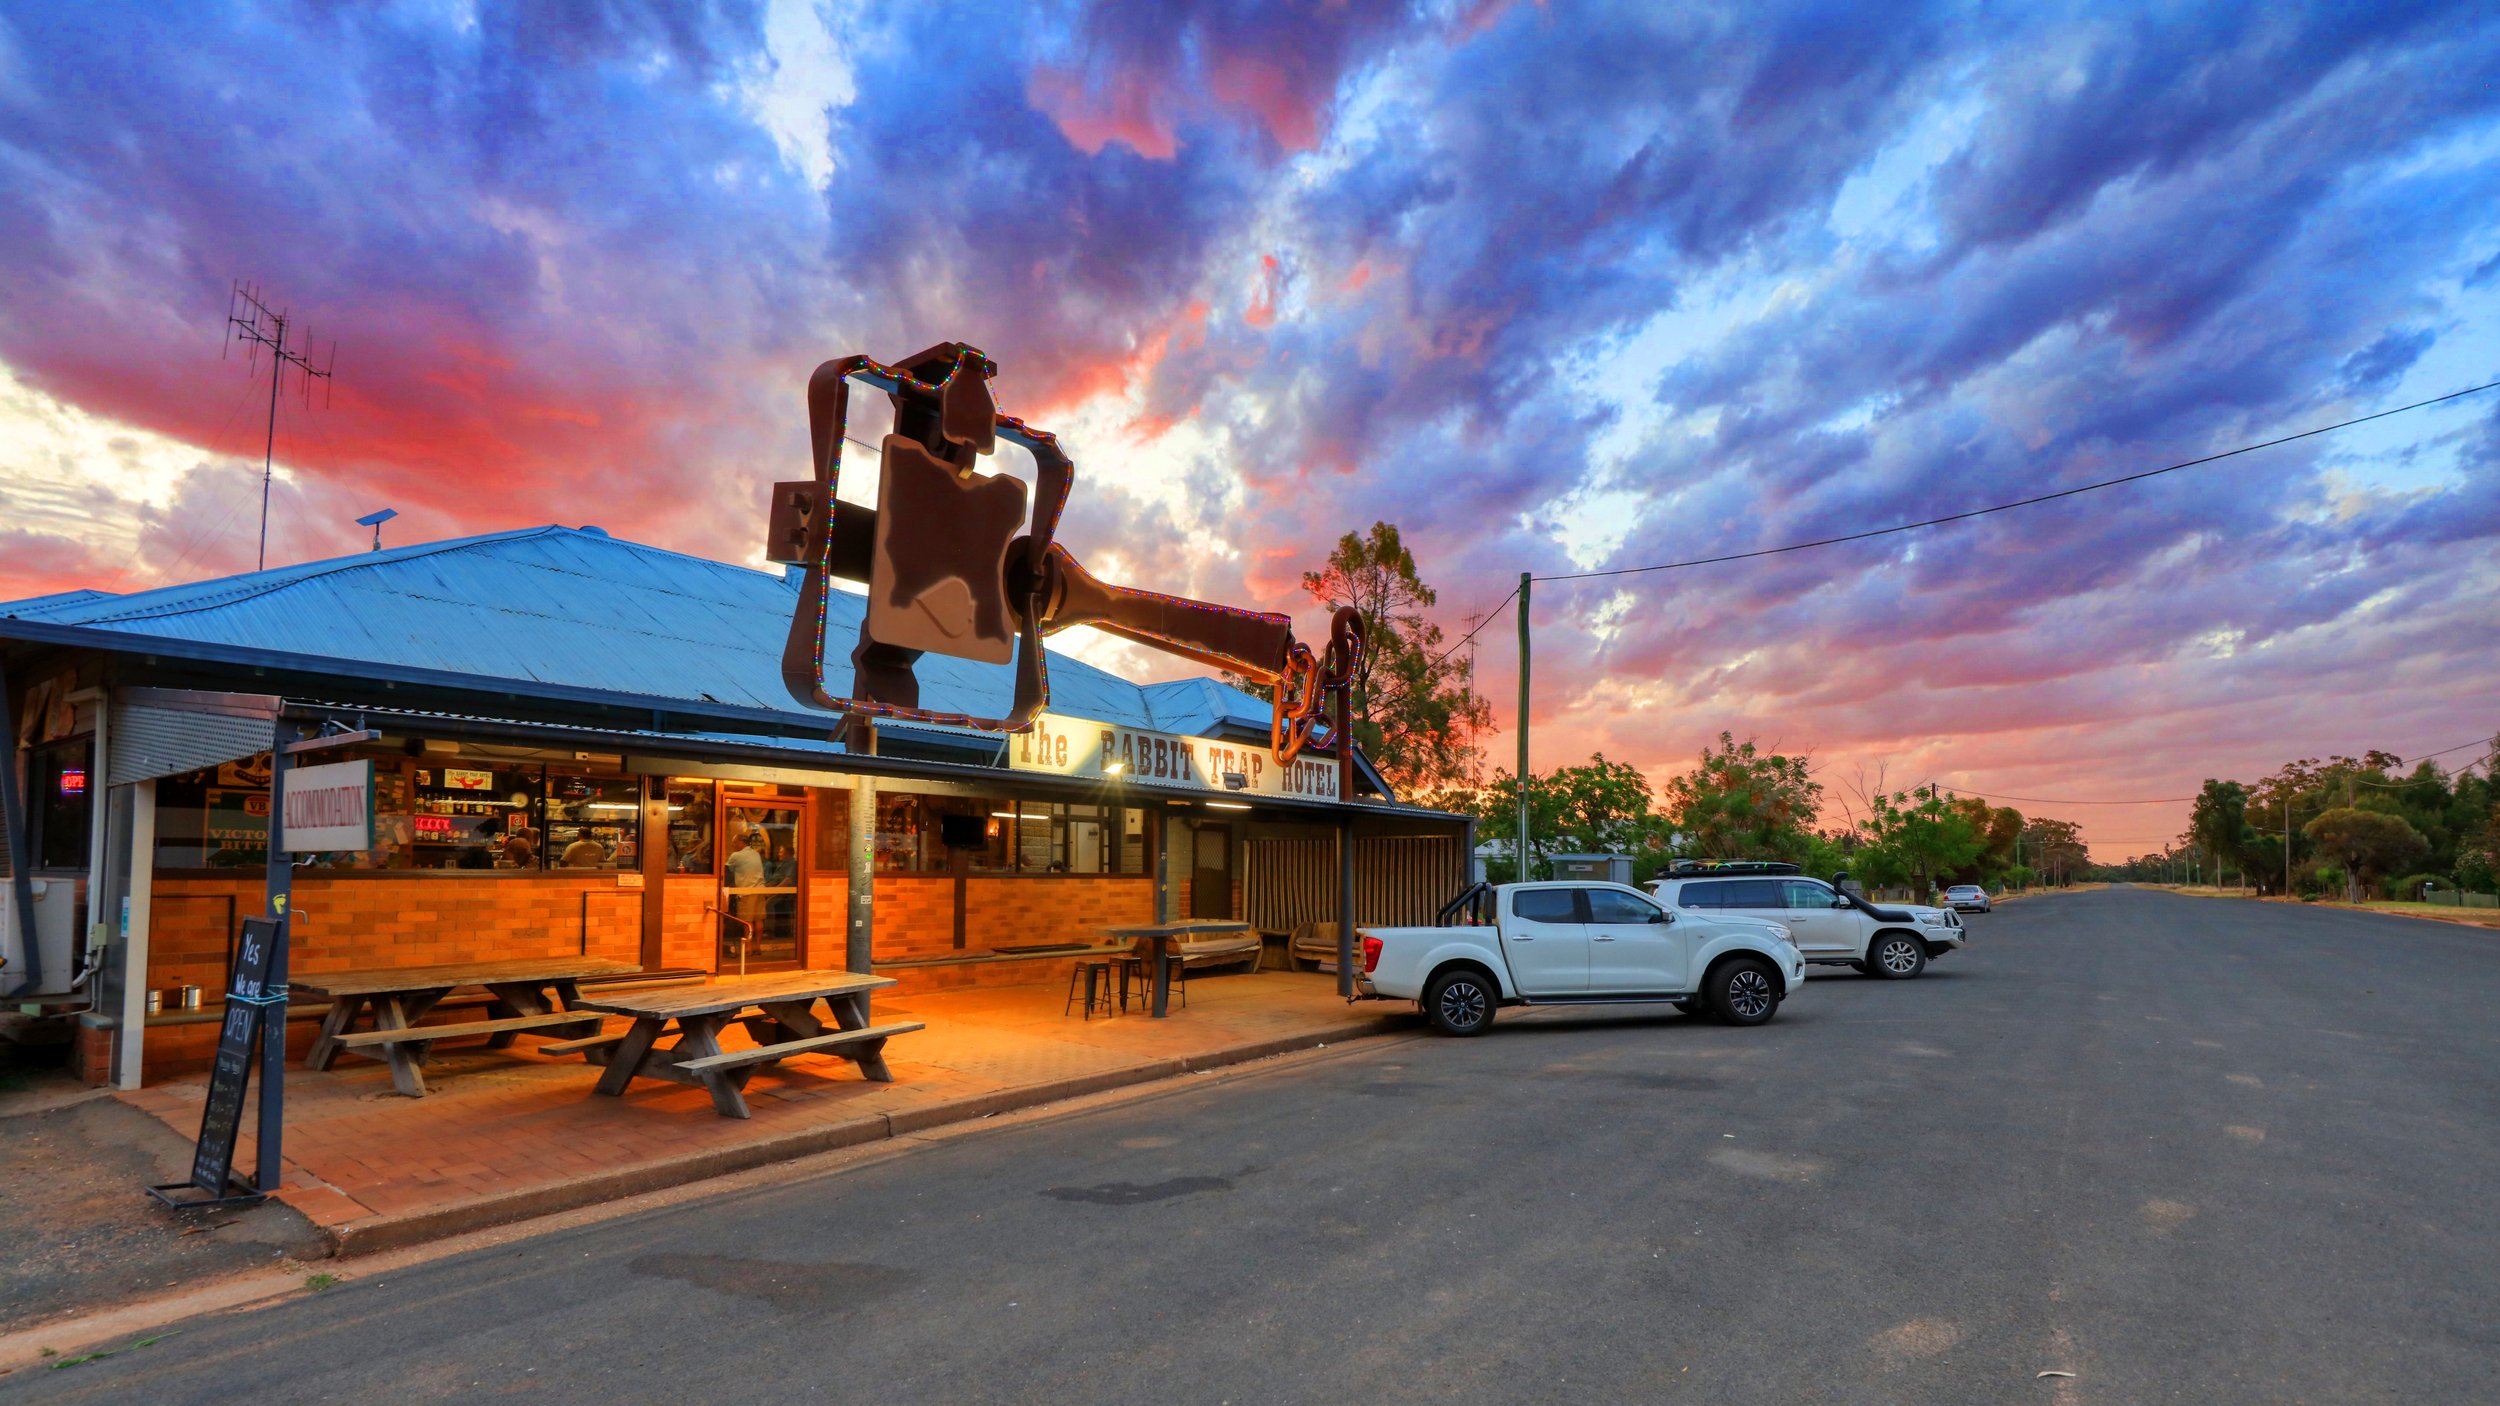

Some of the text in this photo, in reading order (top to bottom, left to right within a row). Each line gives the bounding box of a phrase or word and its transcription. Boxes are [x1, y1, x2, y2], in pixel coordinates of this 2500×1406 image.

[1017, 721, 1336, 797] The RABBIT TRAP HOTEL
[64, 774, 85, 788] OPE
[250, 800, 267, 811] VB
[284, 785, 365, 829] ACCOMMODATION
[208, 828, 268, 840] VICTO
[220, 840, 267, 850] BITT
[243, 933, 261, 965] Yes
[235, 973, 261, 999] We are
[226, 1007, 254, 1044] OPEN
